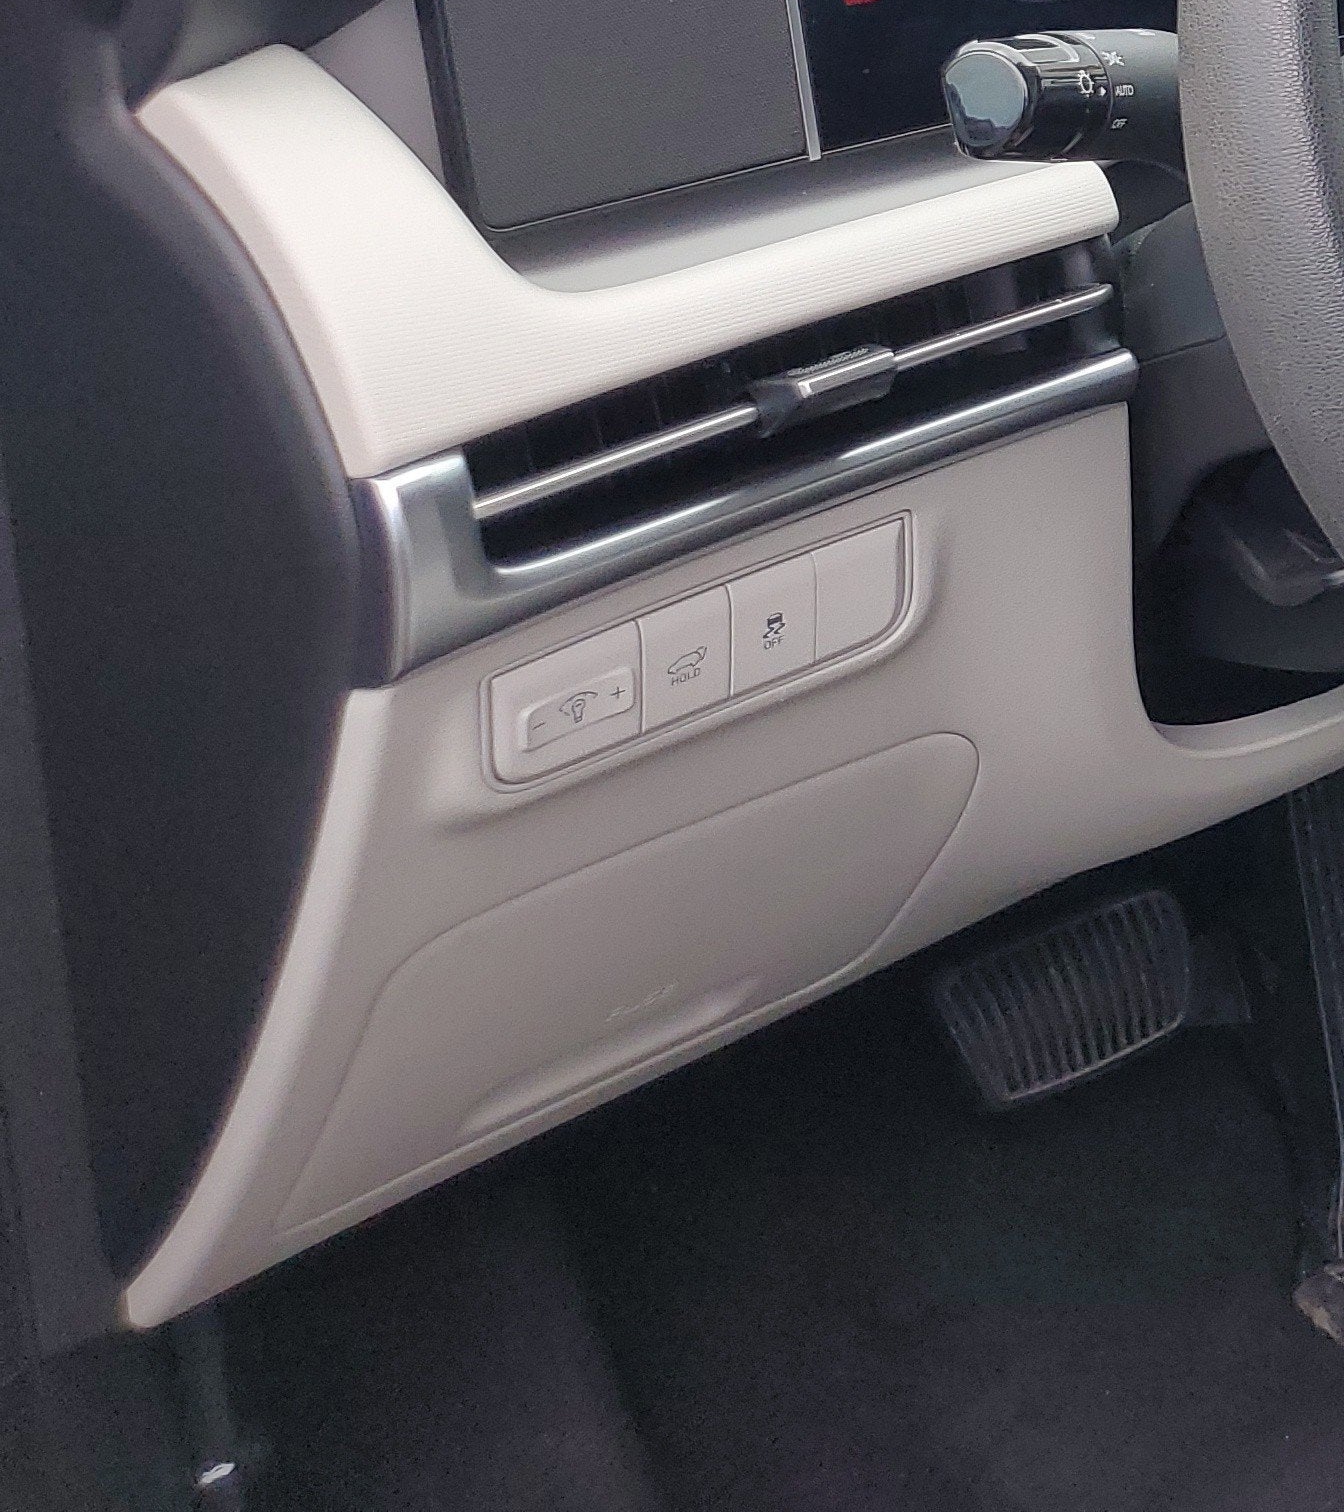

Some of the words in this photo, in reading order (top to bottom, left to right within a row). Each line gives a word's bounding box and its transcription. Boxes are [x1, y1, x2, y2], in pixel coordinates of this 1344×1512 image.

[1115, 84, 1135, 97] AUTO
[763, 635, 785, 651] OFF
[671, 667, 701, 687] HOLD
